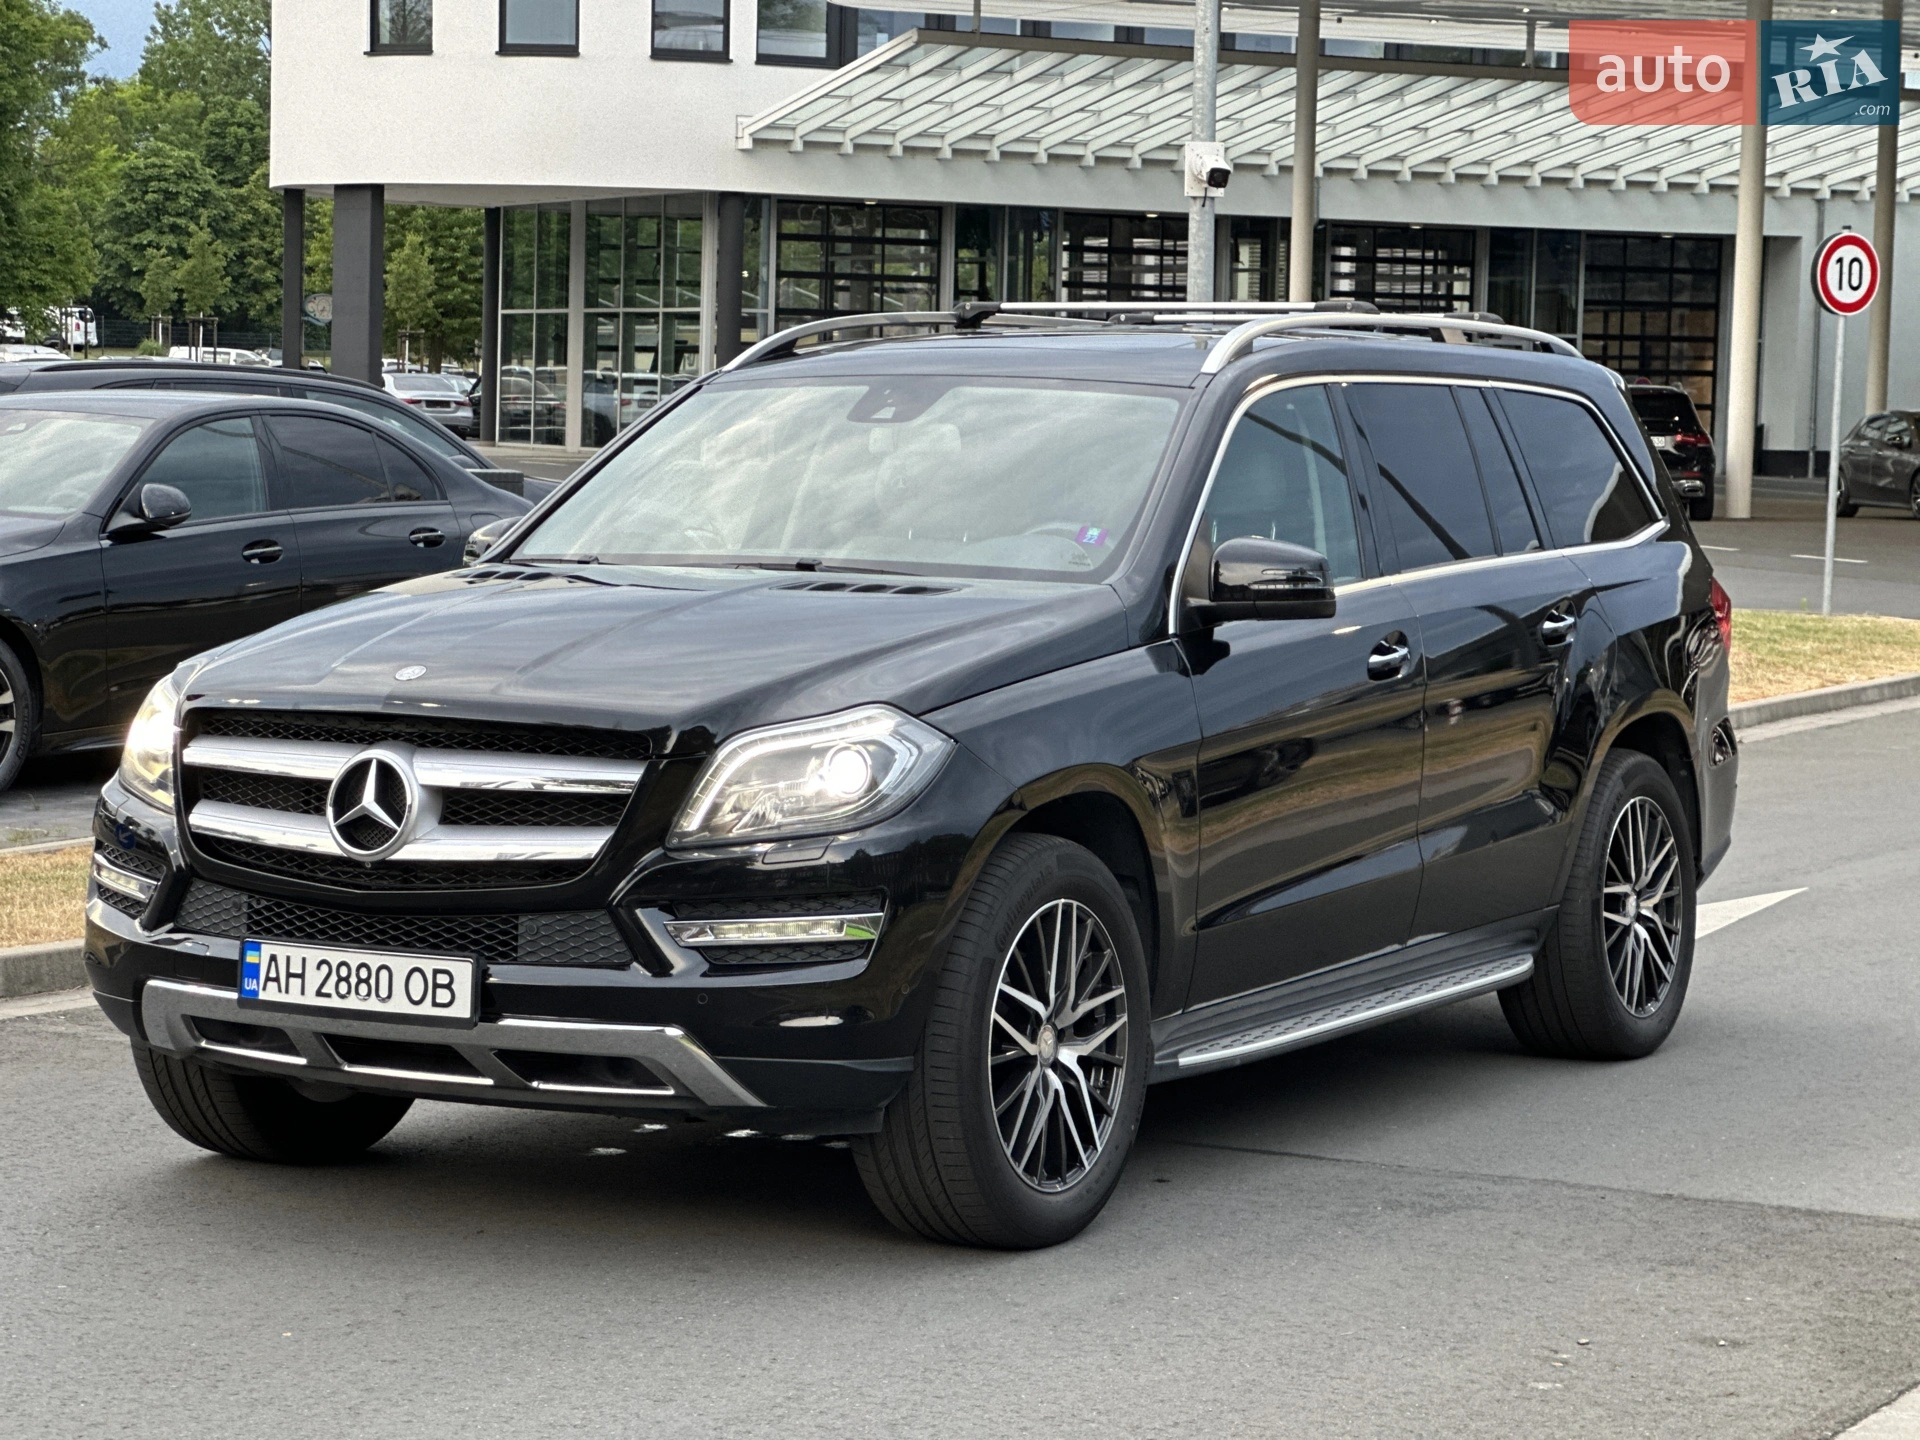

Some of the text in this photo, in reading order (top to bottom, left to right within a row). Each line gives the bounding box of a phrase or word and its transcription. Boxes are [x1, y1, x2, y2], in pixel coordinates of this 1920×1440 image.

[1835, 256, 1863, 292] 10
[244, 978, 259, 991] UA
[261, 953, 457, 1009] AH 2880 OB
